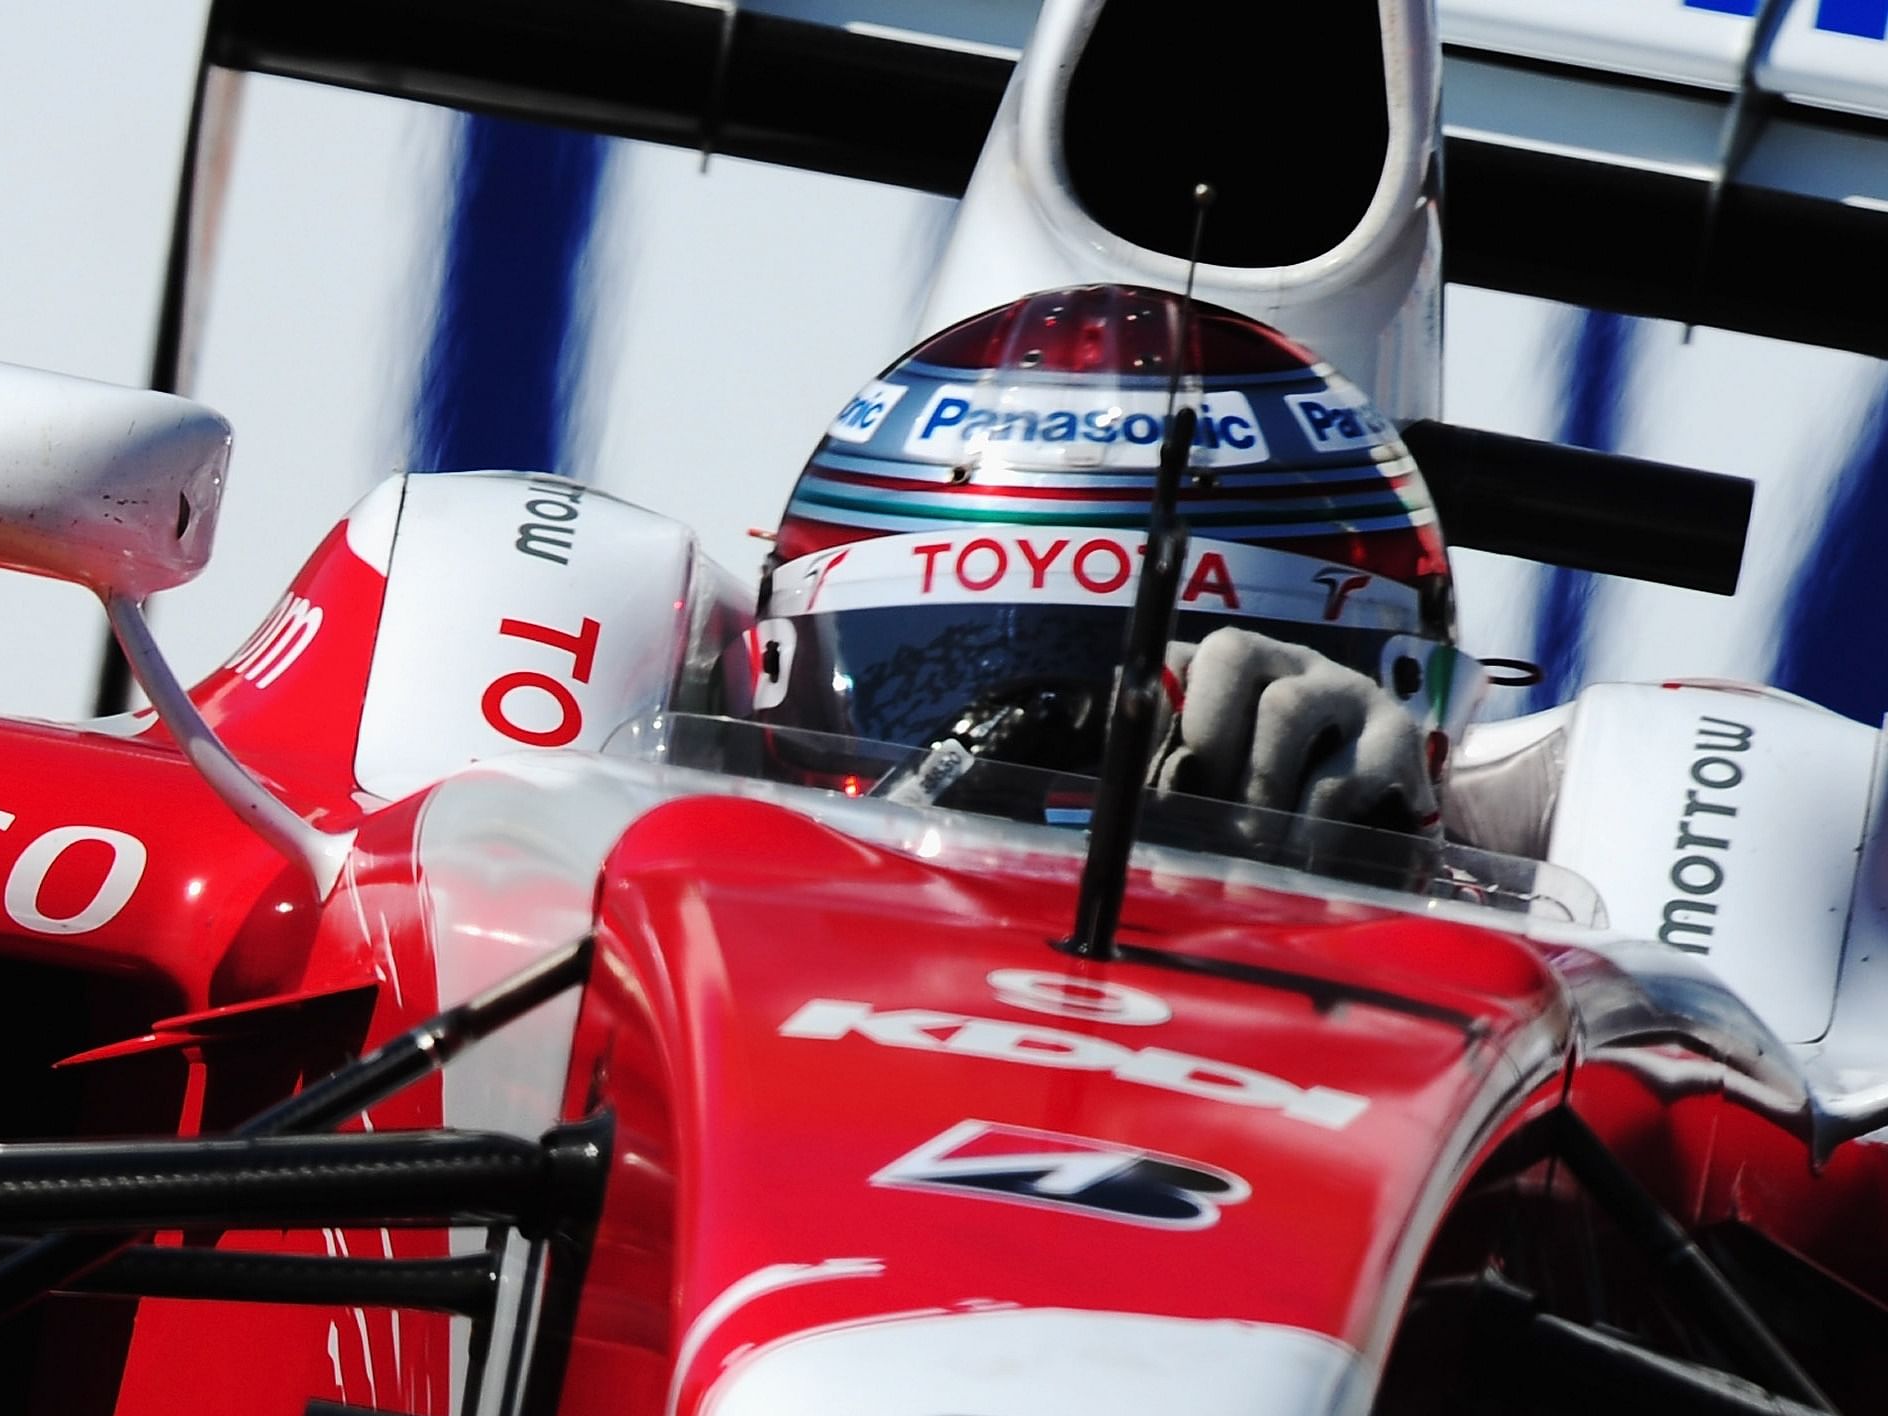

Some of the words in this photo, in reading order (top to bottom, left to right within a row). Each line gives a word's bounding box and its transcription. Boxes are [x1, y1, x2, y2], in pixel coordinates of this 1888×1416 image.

[913, 538, 1240, 609] TOYOA
[481, 616, 601, 748] TO
[1658, 715, 1754, 956] morrow
[776, 998, 1372, 1132] KDDI
